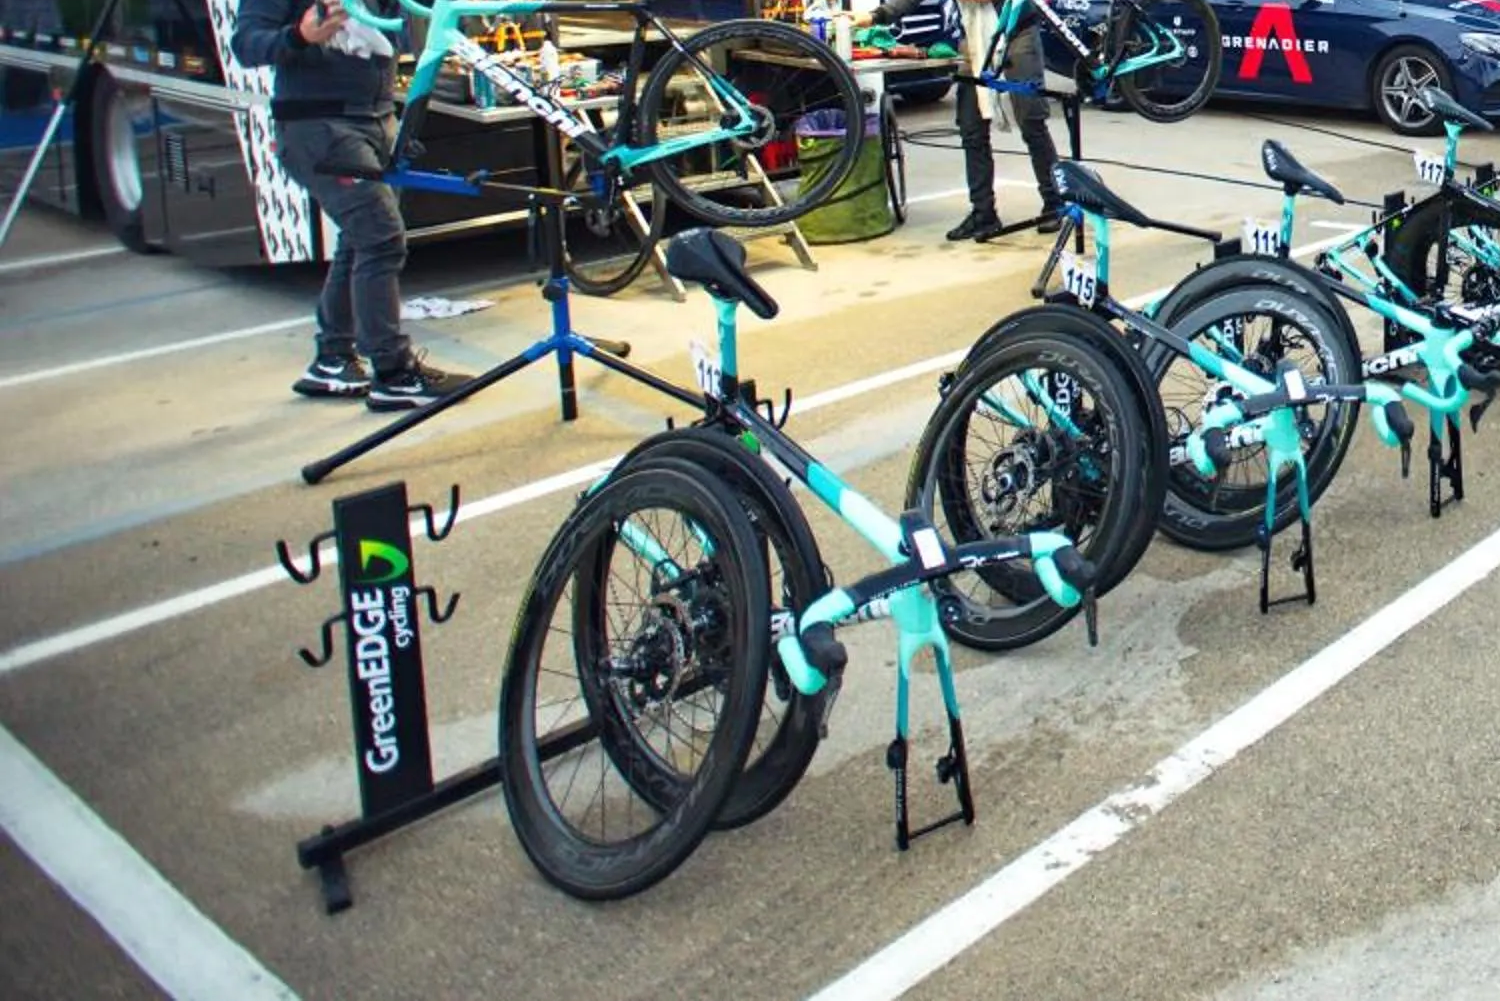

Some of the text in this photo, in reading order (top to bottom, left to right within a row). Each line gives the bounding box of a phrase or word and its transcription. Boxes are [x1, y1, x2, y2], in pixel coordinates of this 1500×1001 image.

[1221, 35, 1330, 54] GRENADIER
[1420, 159, 1443, 183] 117
[1252, 227, 1279, 254] 111
[1067, 267, 1095, 300] 115
[388, 585, 414, 648] cycling
[351, 587, 400, 773] GreenEDGE
